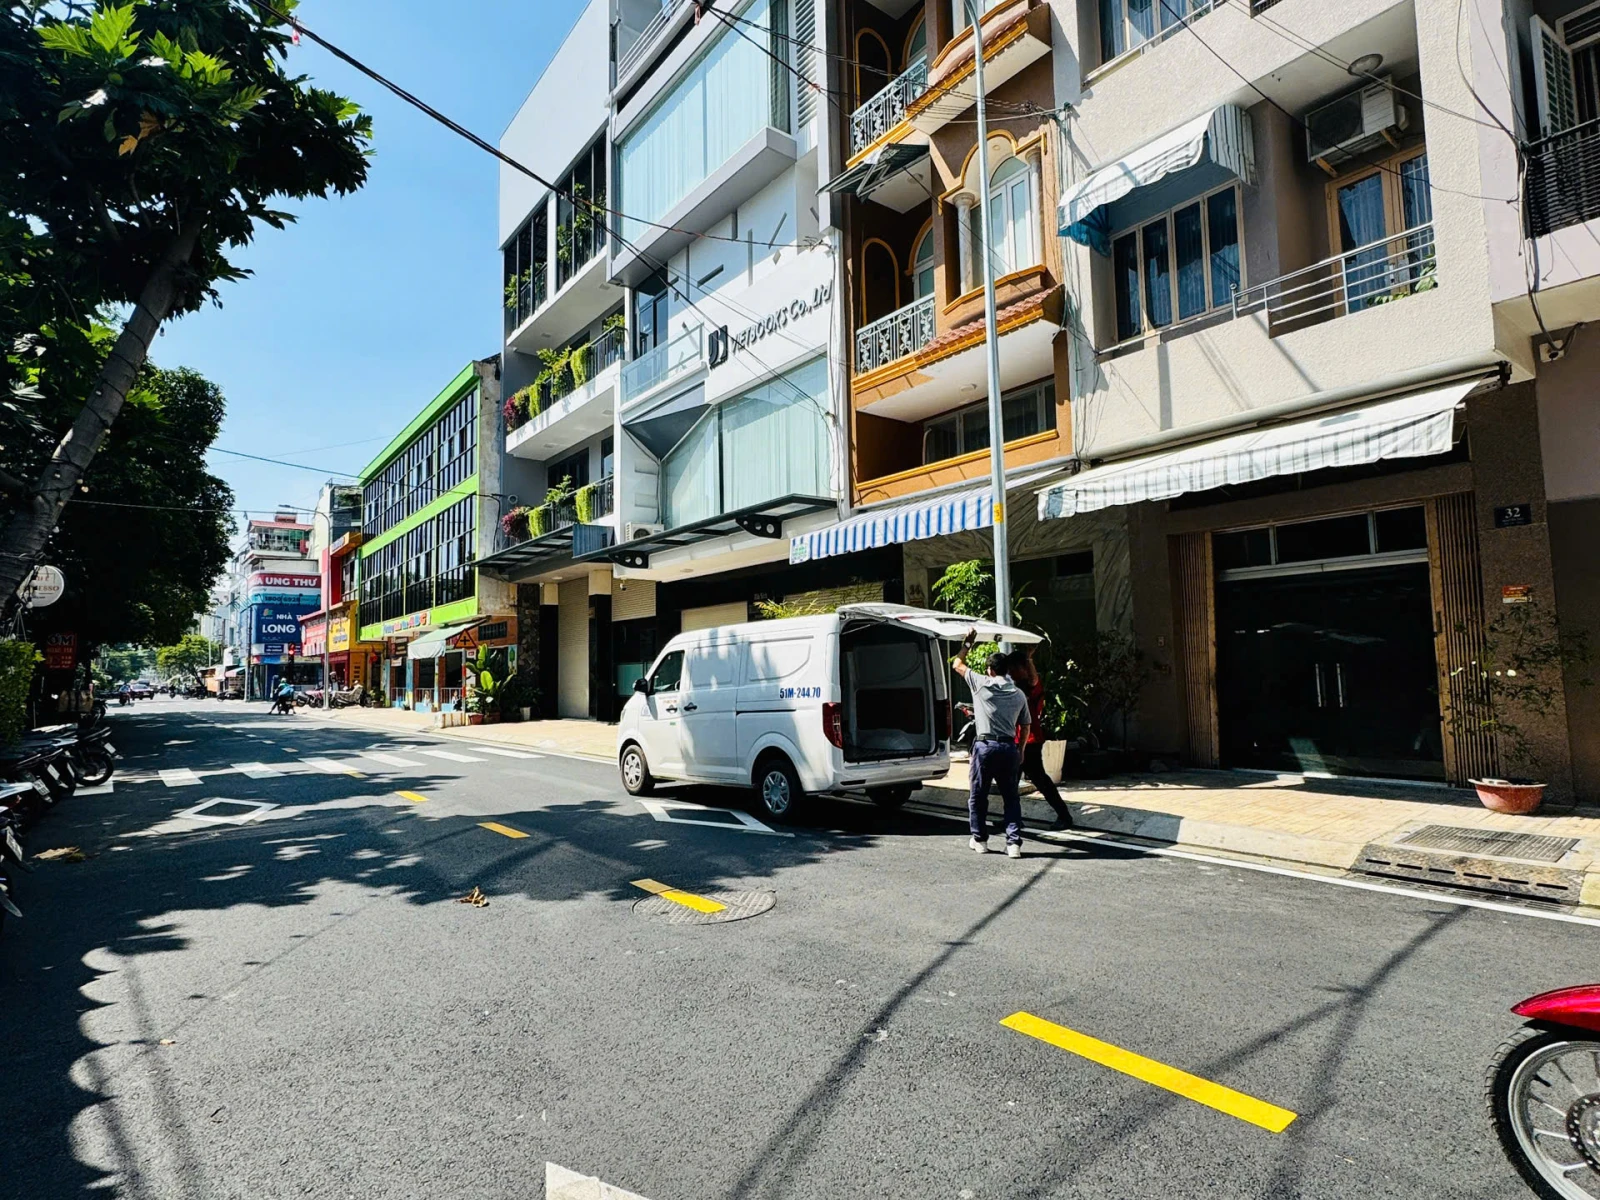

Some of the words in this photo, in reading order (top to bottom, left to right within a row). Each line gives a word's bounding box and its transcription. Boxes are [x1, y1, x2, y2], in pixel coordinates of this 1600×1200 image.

[1505, 507, 1521, 518] 32
[265, 577, 290, 585] UNG
[293, 578, 318, 587] THƯ
[276, 612, 293, 620] NHÀ
[262, 624, 296, 634] LONG
[779, 686, 821, 699] 51M-244.70
